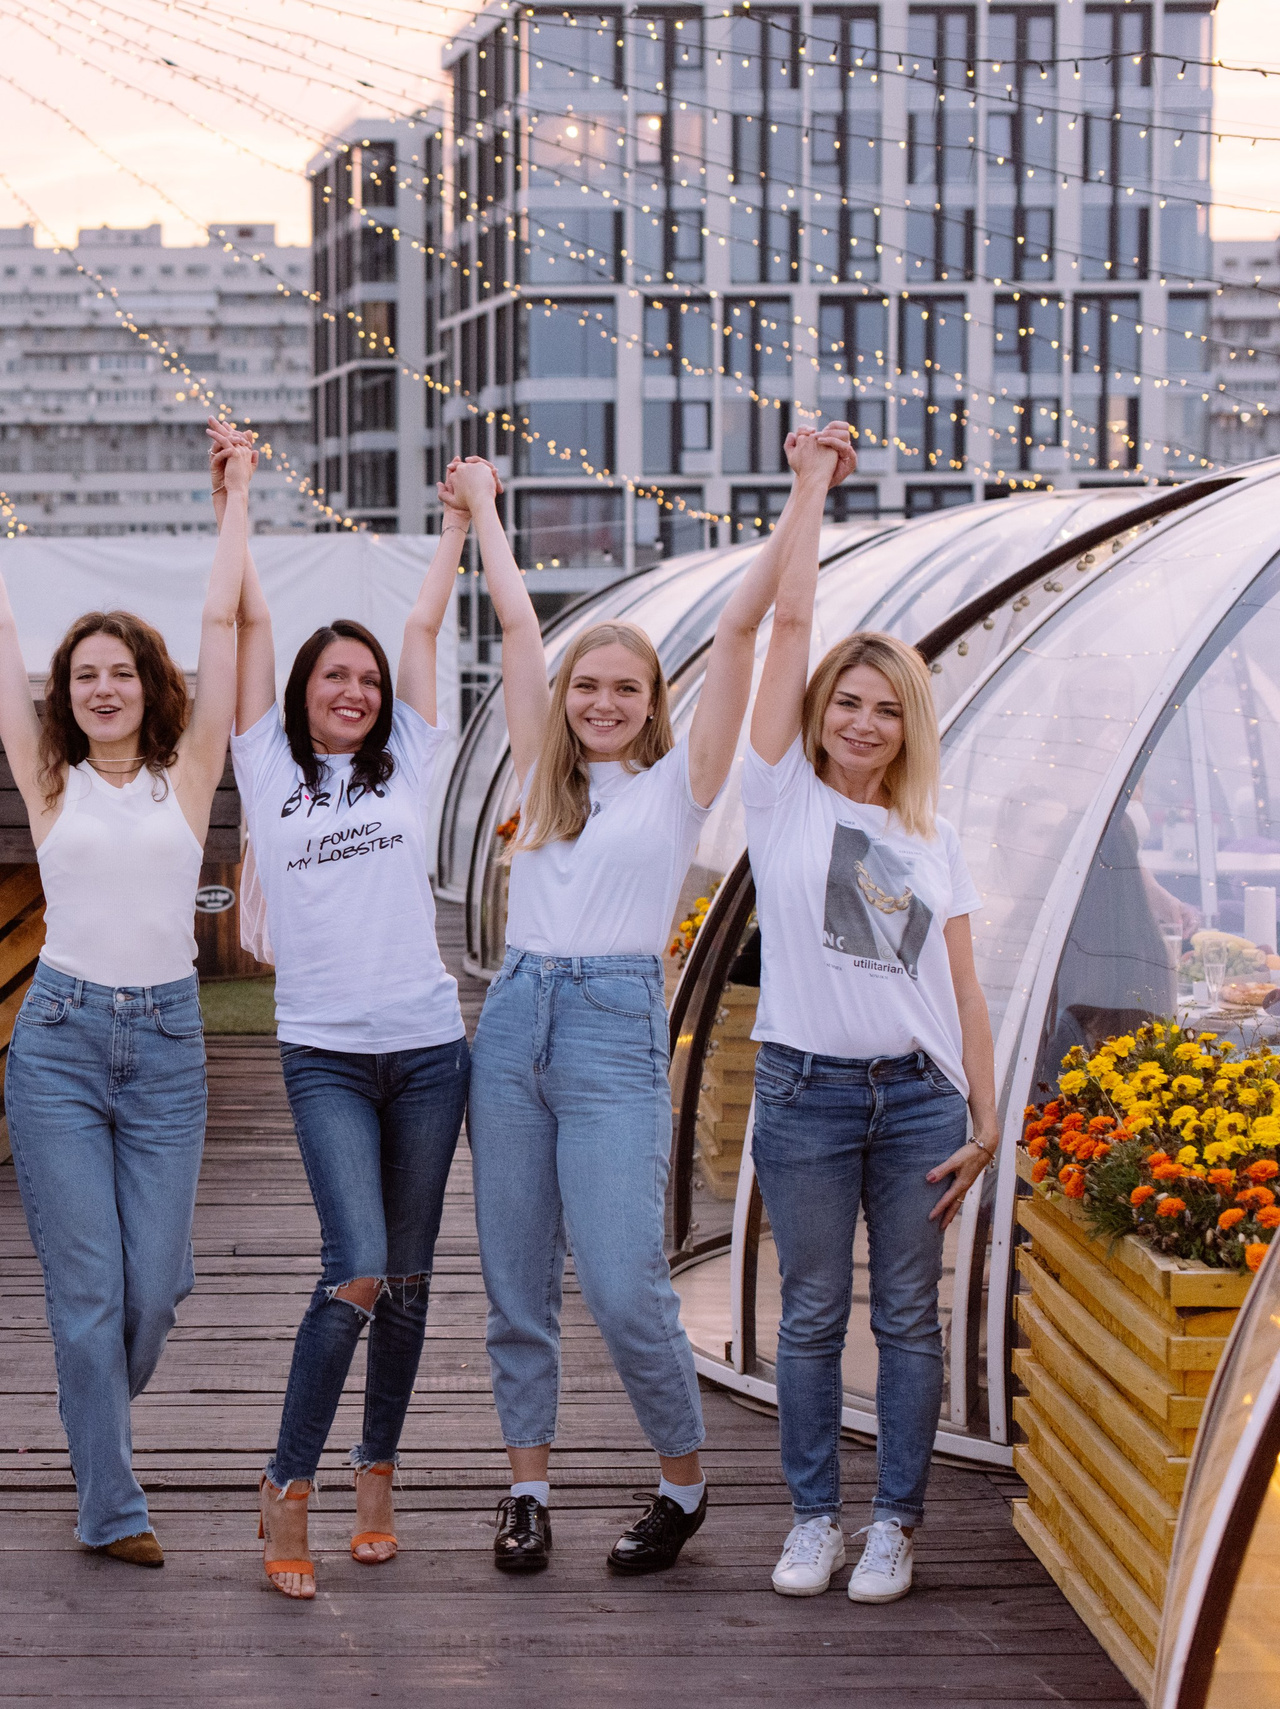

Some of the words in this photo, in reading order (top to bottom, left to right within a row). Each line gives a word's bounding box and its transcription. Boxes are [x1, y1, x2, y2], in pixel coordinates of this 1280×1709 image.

[286, 857, 312, 871] MY
[318, 834, 404, 864] LOBSTER
[306, 839, 312, 853] I
[320, 822, 382, 850] FOUND
[853, 959, 904, 975] utilitarian
